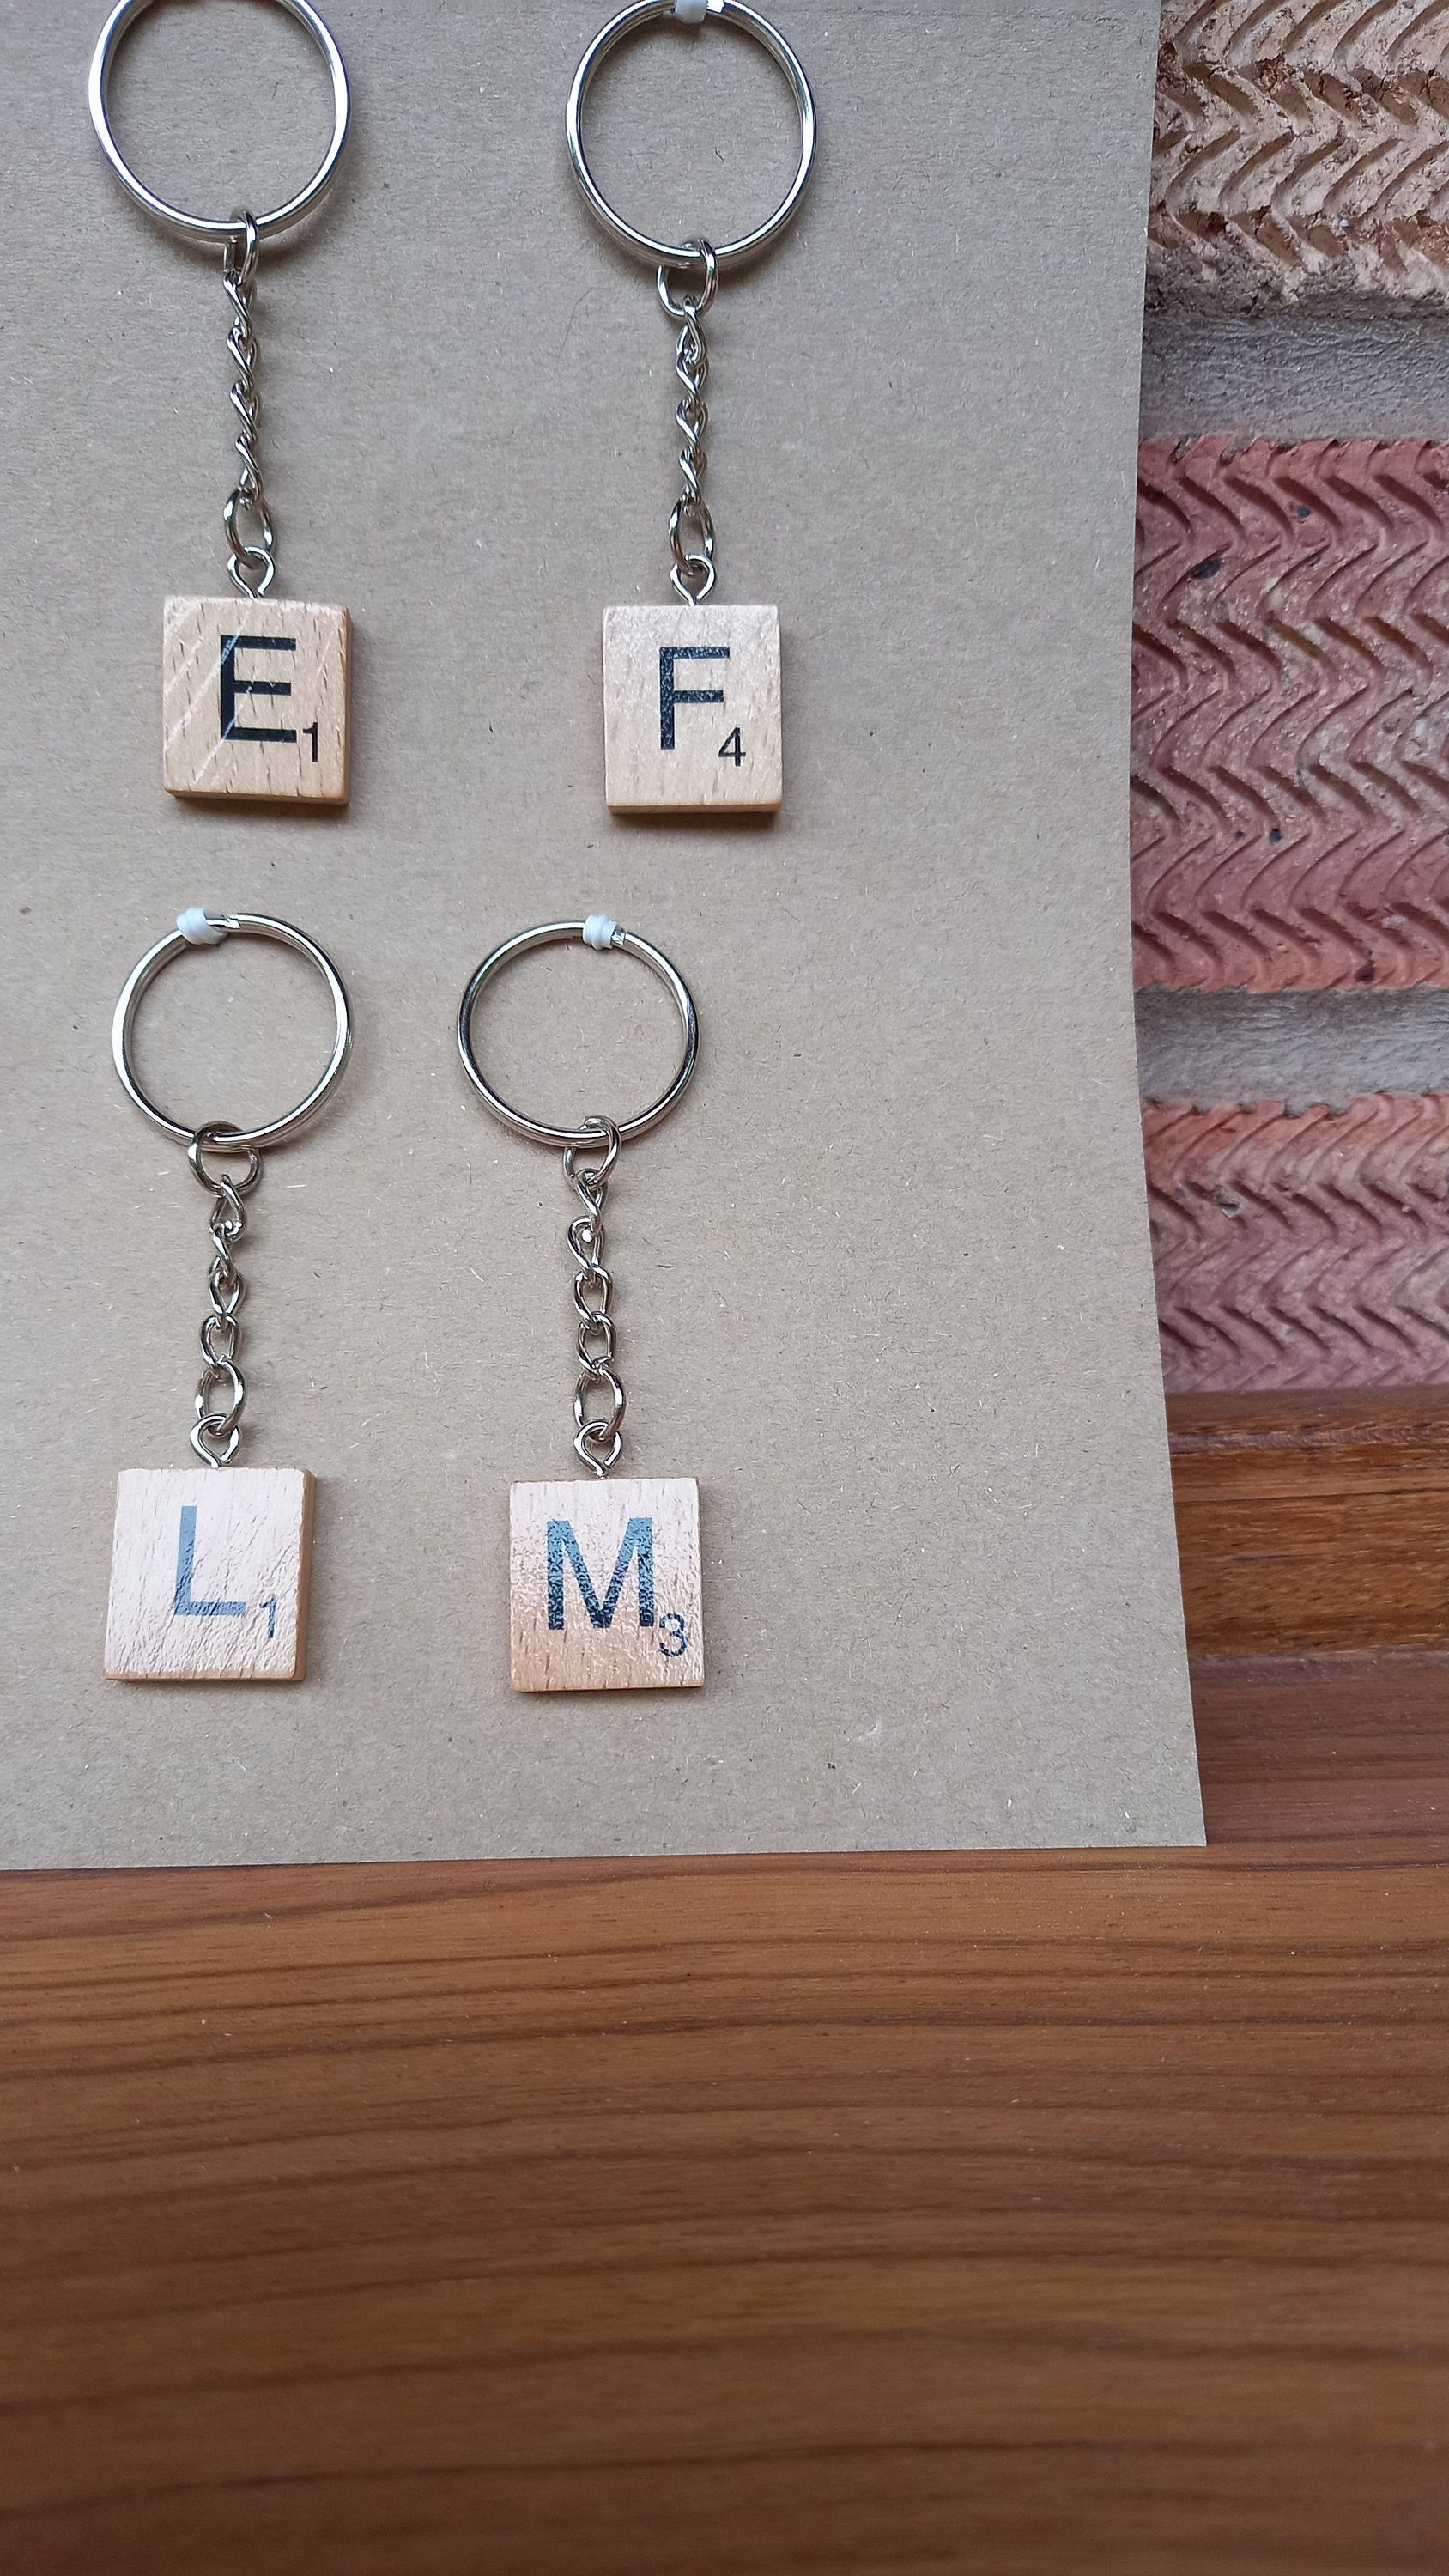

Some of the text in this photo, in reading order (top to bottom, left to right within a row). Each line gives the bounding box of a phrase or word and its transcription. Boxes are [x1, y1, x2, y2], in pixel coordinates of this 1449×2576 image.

[221, 635, 297, 743] E
[659, 647, 731, 750] F
[303, 722, 318, 762] 1
[718, 727, 746, 767] 4
[174, 1506, 246, 1616] L
[547, 1517, 654, 1630] M
[260, 1594, 276, 1638] 1
[659, 1613, 688, 1657] 3
